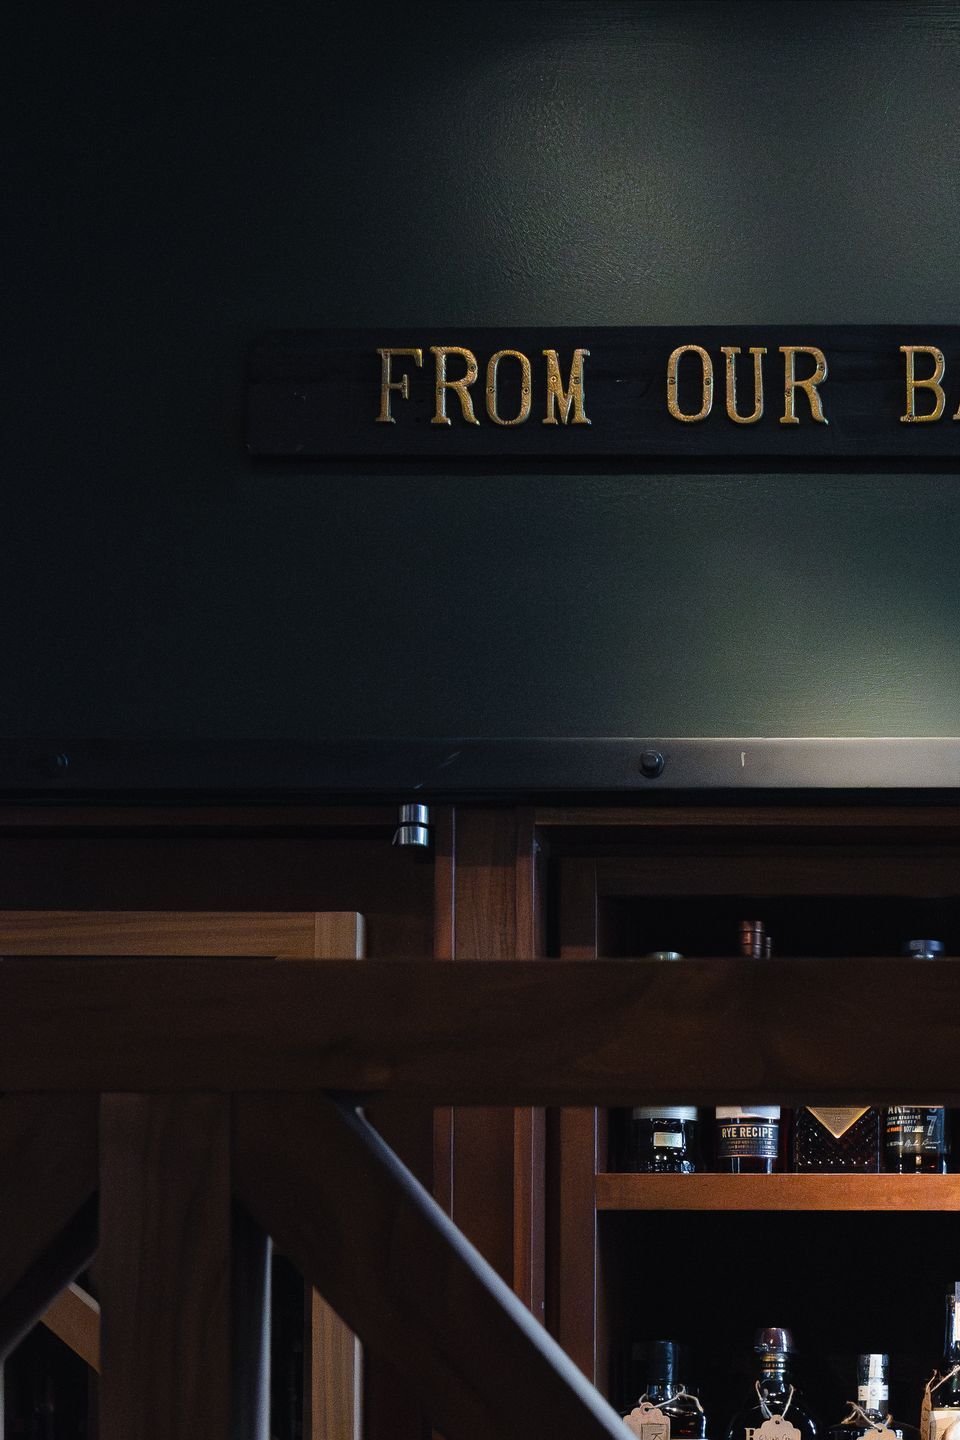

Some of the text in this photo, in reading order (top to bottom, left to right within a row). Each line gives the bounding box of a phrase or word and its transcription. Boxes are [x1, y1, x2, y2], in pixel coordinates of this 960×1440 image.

[375, 346, 591, 426] FROM
[666, 345, 828, 425] OUR
[721, 1127, 774, 1139] RYE RECIPE
[926, 1115, 938, 1136] 7
